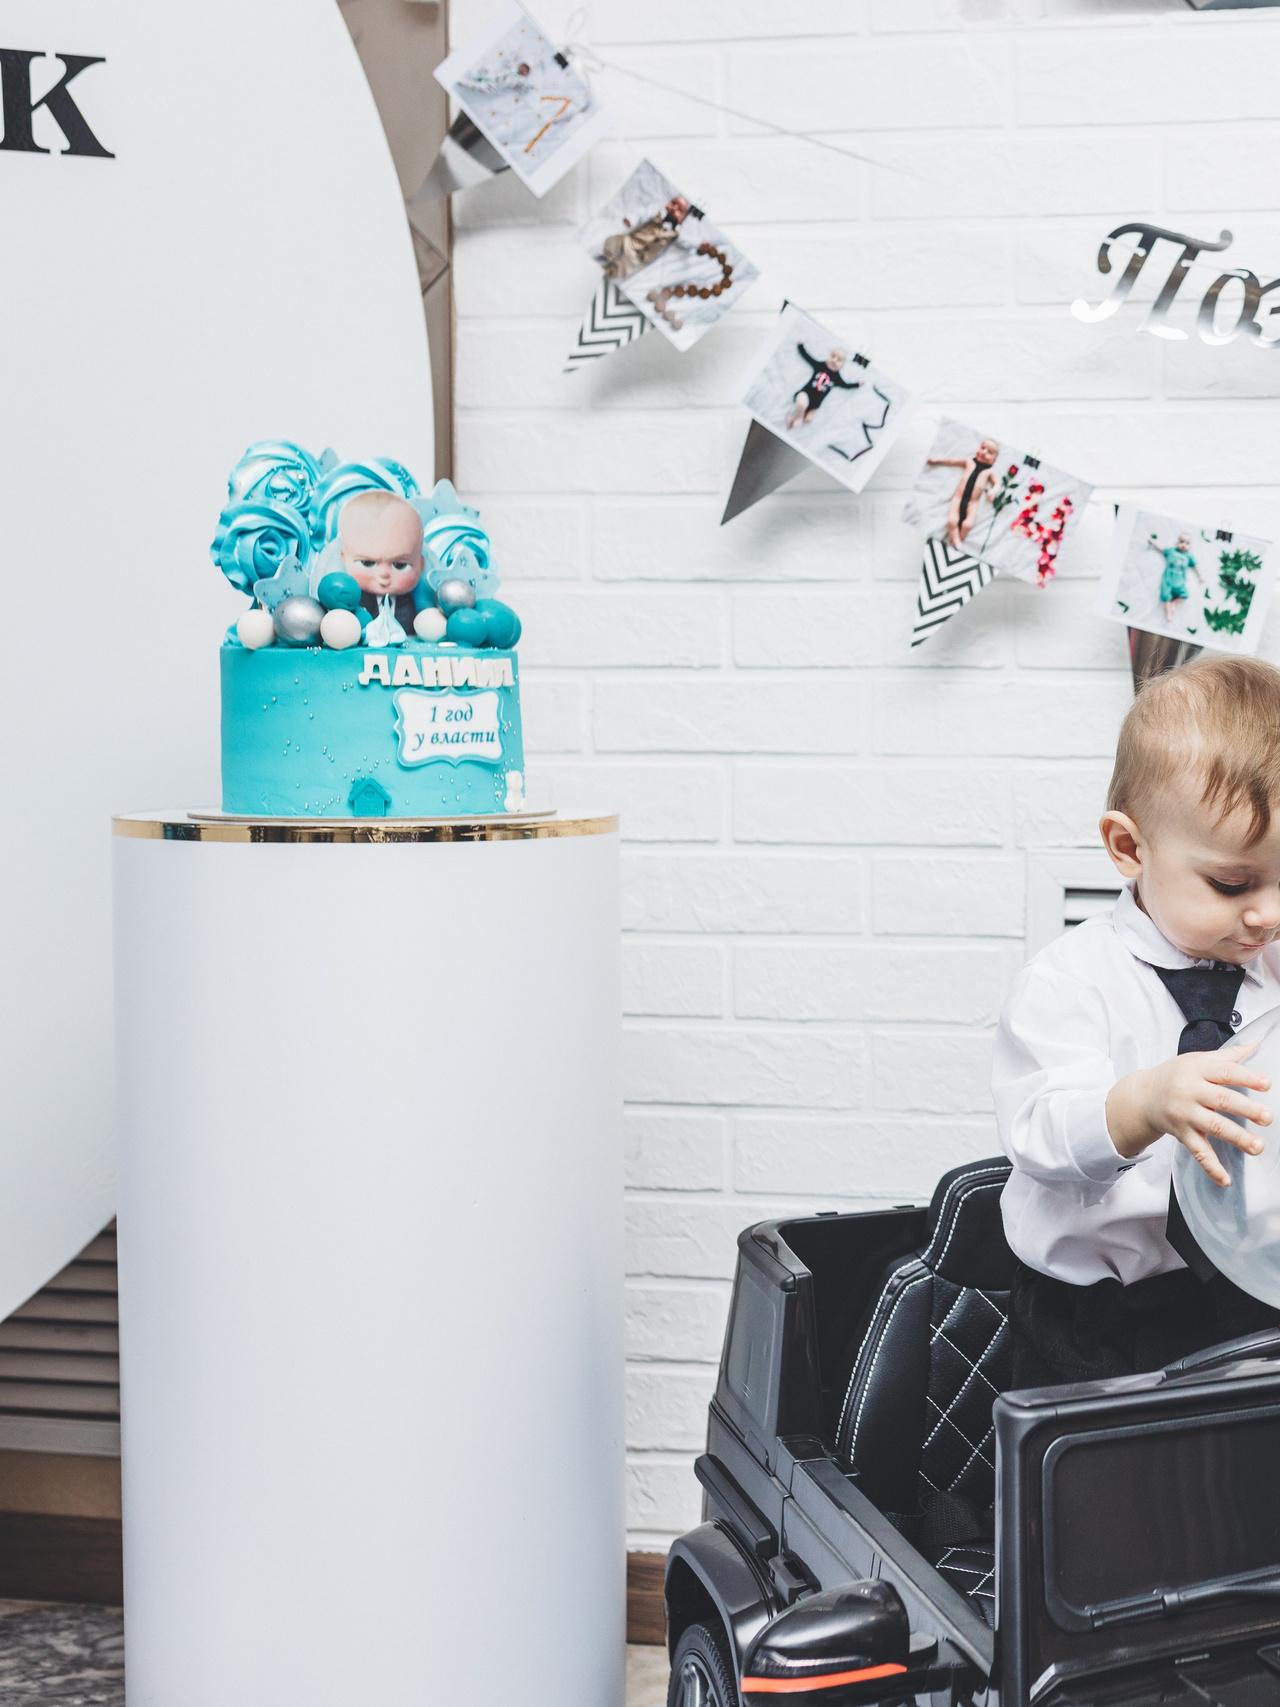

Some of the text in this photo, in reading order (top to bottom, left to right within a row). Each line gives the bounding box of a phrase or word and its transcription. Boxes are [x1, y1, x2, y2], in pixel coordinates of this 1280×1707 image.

[1010, 477, 1074, 589] 4
[357, 653, 516, 689] ДАНИИЛ
[429, 701, 474, 724] 1 год
[412, 730, 497, 752] у власти
